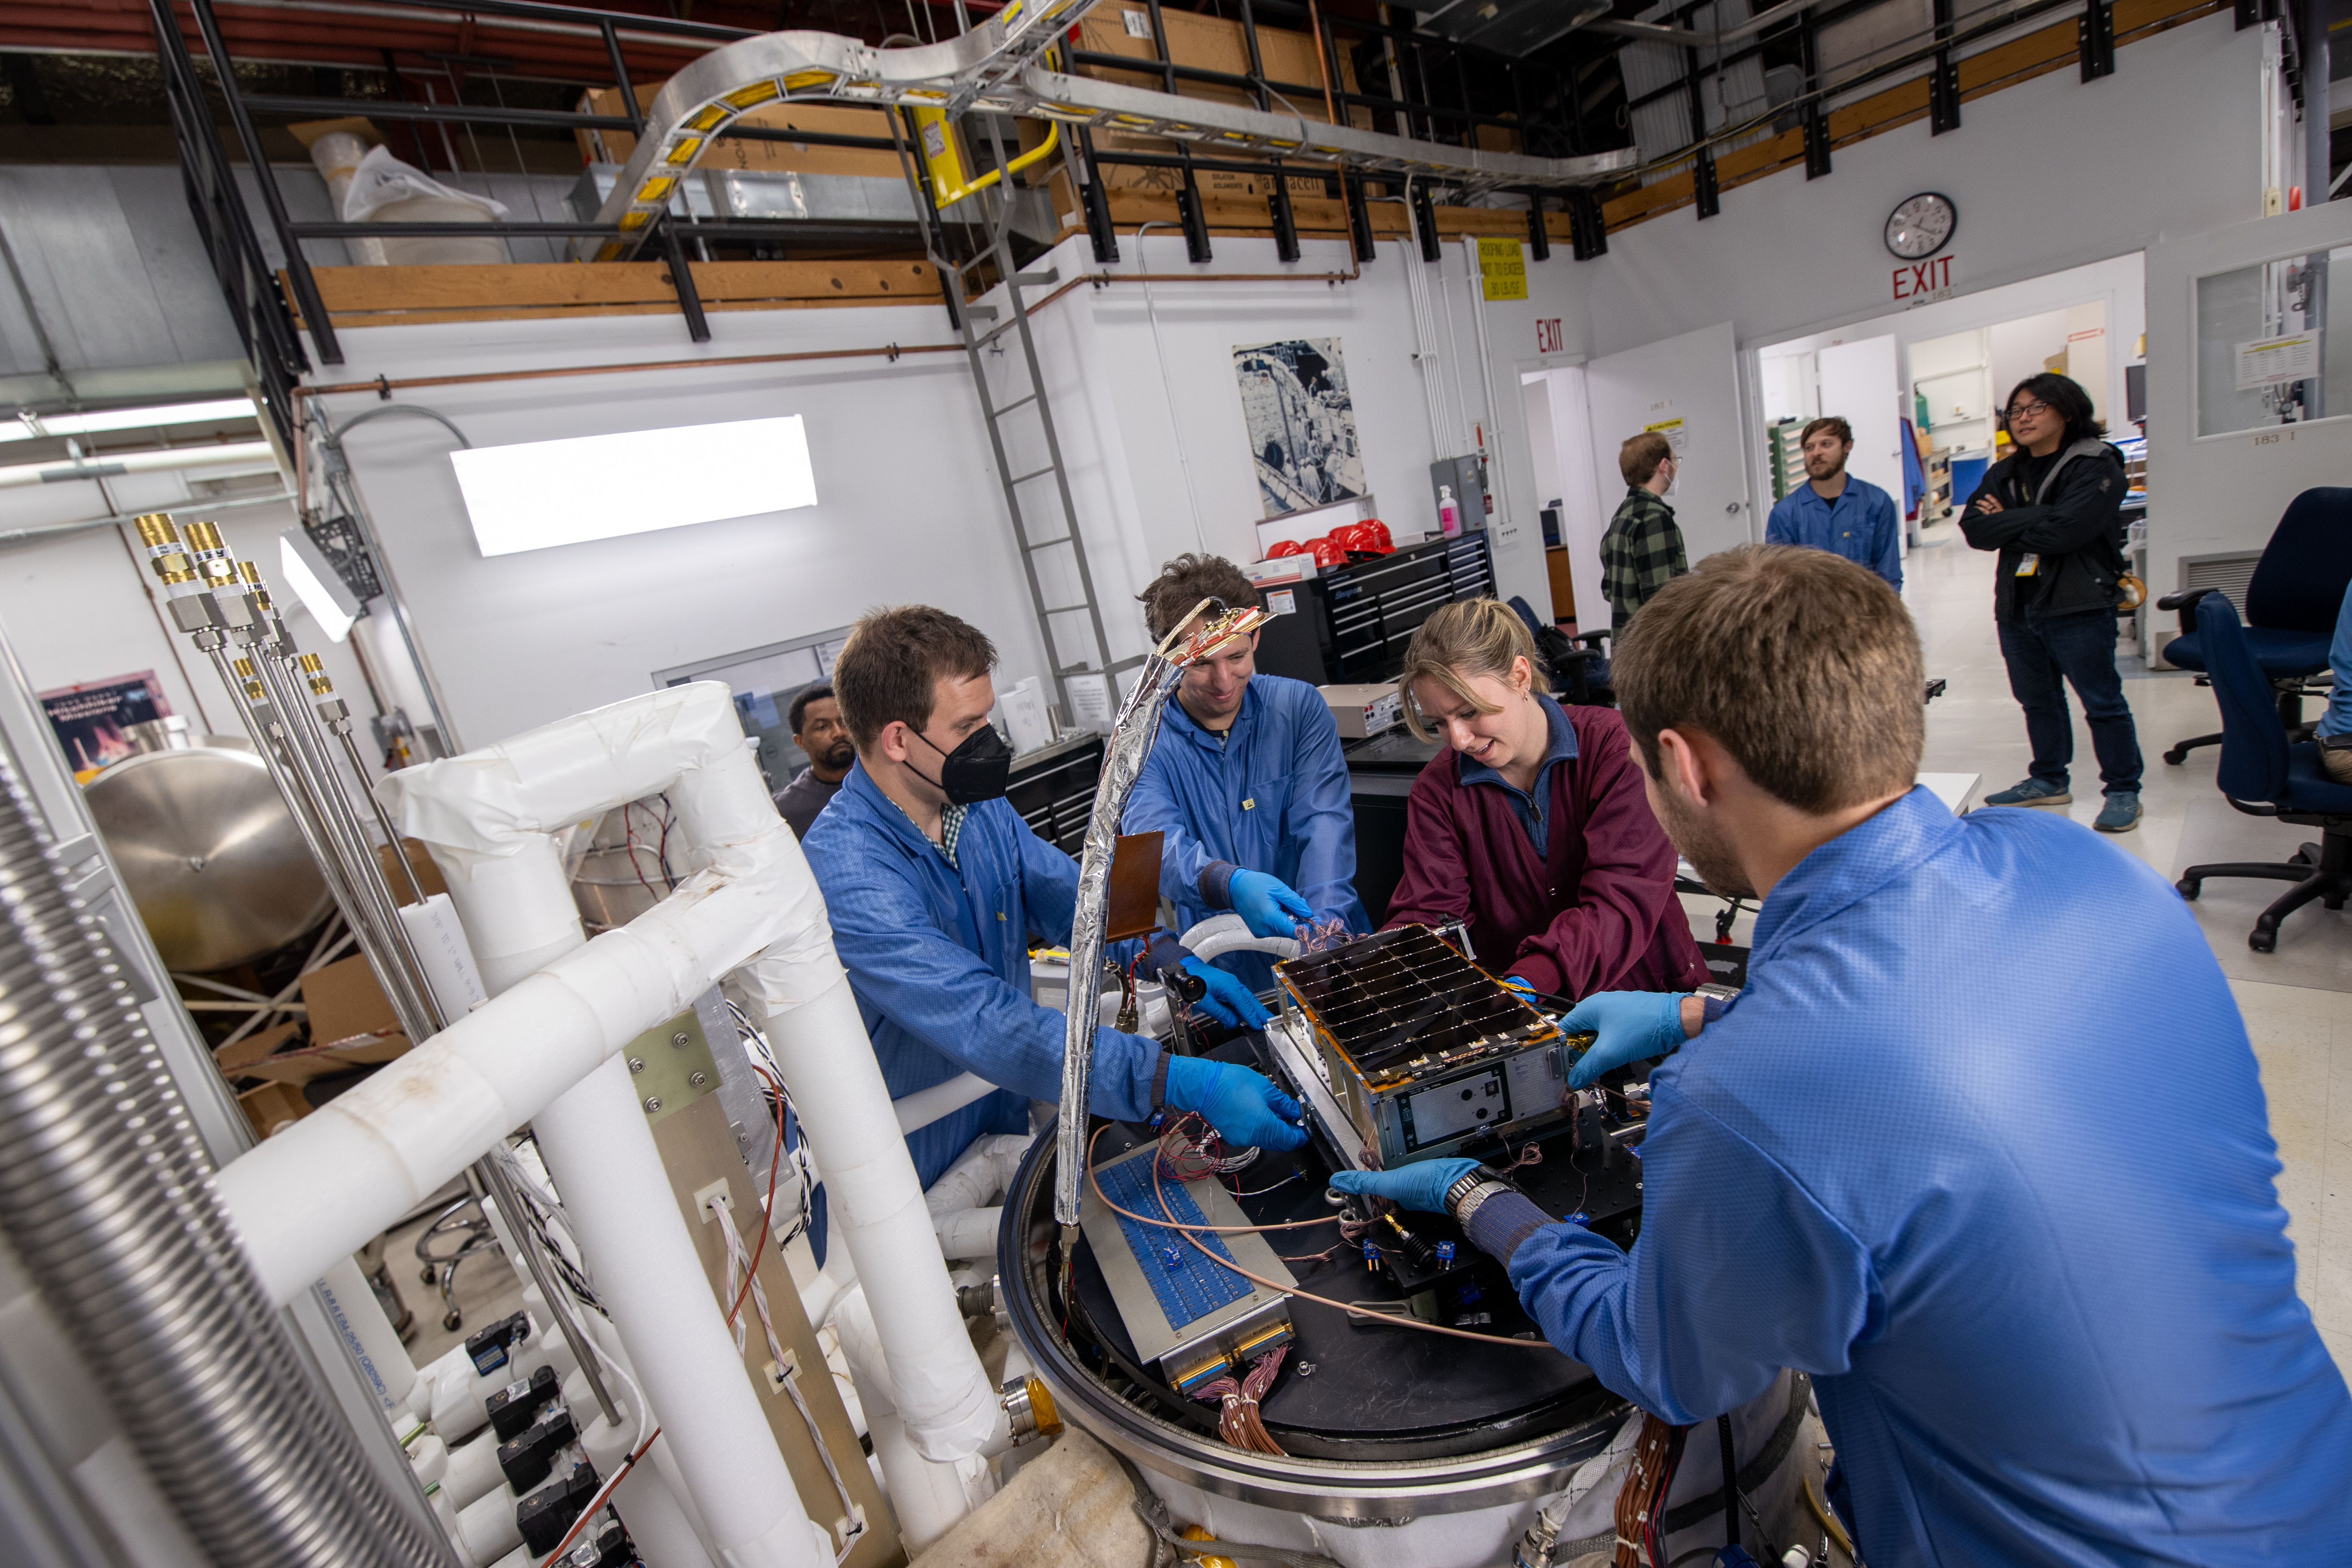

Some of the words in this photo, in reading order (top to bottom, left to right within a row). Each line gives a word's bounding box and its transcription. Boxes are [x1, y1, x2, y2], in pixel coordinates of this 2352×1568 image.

[1505, 242, 1520, 257] LOAD
[1494, 262, 1503, 276] TO
[1504, 261, 1525, 276] EXCEED
[1893, 254, 1955, 300] EXIT
[1536, 318, 1563, 353] EXIT
[1653, 420, 1681, 430] CAUTION
[2254, 433, 2280, 446] 183
